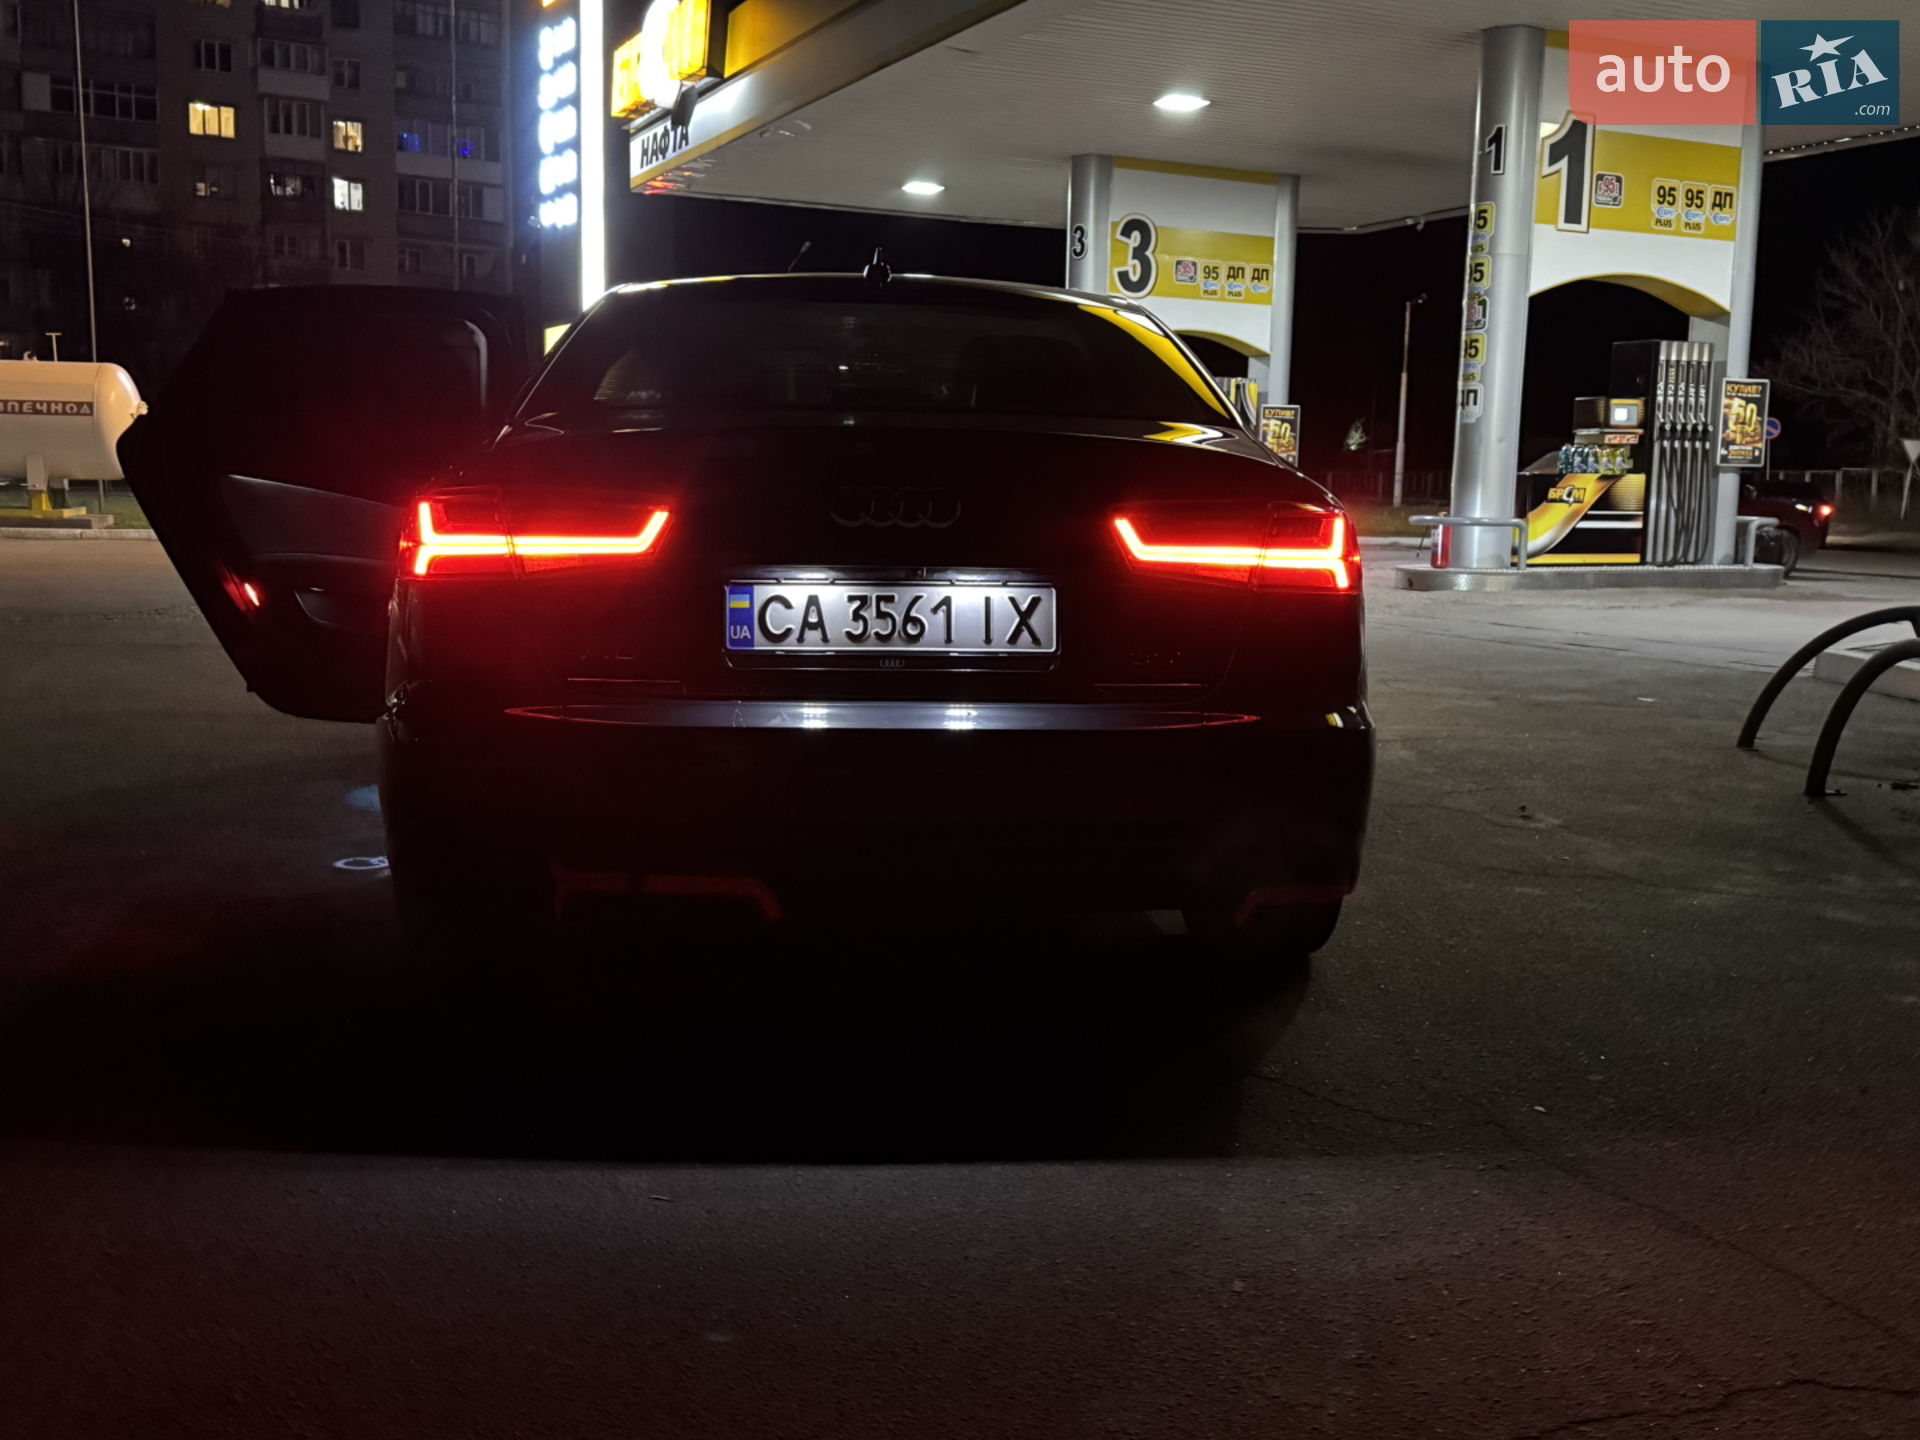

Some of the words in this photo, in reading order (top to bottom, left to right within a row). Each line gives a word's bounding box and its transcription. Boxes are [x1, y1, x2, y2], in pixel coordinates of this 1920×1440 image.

[640, 125, 689, 169] НАФТА
[1486, 125, 1504, 173] 1
[1545, 116, 1591, 230] 1
[1657, 185, 1677, 206] 95
[1685, 188, 1704, 209] 95
[1712, 190, 1733, 212] ДП
[1476, 209, 1488, 229] 5
[1655, 218, 1672, 227] PLUS
[1685, 221, 1701, 231] PLUS
[1072, 224, 1087, 258] 3
[1115, 216, 1154, 296] 3
[1203, 265, 1219, 280] 95
[1226, 266, 1245, 281] ДП
[1251, 268, 1269, 283] ДП
[730, 625, 751, 639] UA
[758, 594, 830, 643] CA
[844, 594, 954, 644] 3561
[982, 595, 1043, 646] IX
